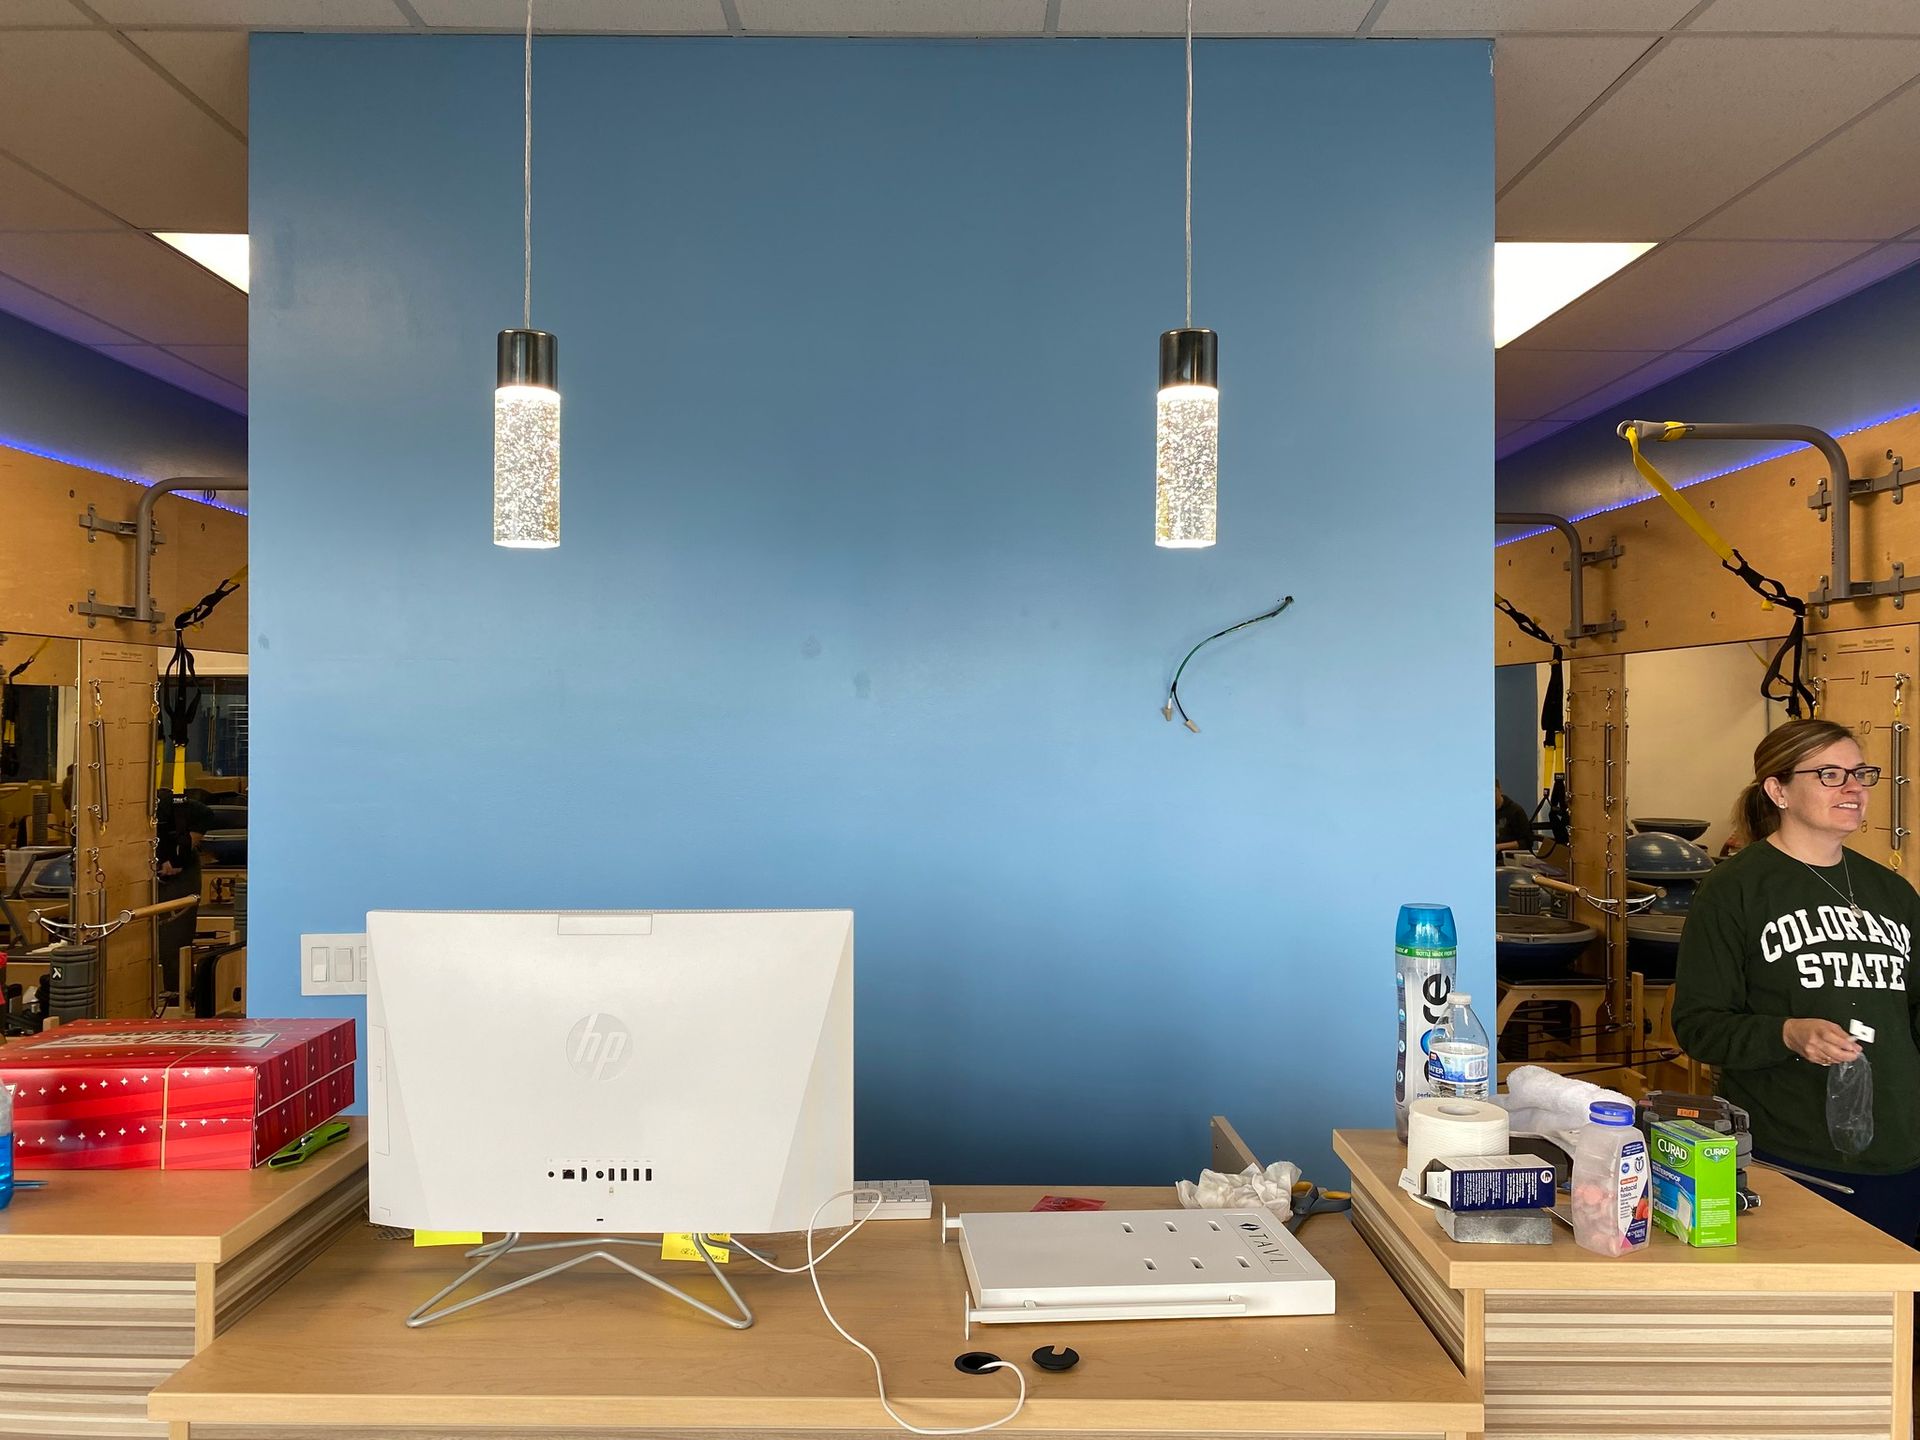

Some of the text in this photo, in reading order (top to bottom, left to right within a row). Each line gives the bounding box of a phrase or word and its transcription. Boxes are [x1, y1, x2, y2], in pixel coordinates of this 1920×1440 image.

[1859, 671, 1870, 685] 11
[1859, 720, 1872, 735] 10
[1796, 952, 1906, 991] STATE
[1420, 973, 1451, 1086] ore
[575, 1014, 627, 1080] hp
[1429, 1066, 1444, 1075] ATER
[1657, 1138, 1688, 1161] CURAD
[1703, 1148, 1730, 1157] CURAD
[1249, 1233, 1289, 1263] TAVI
